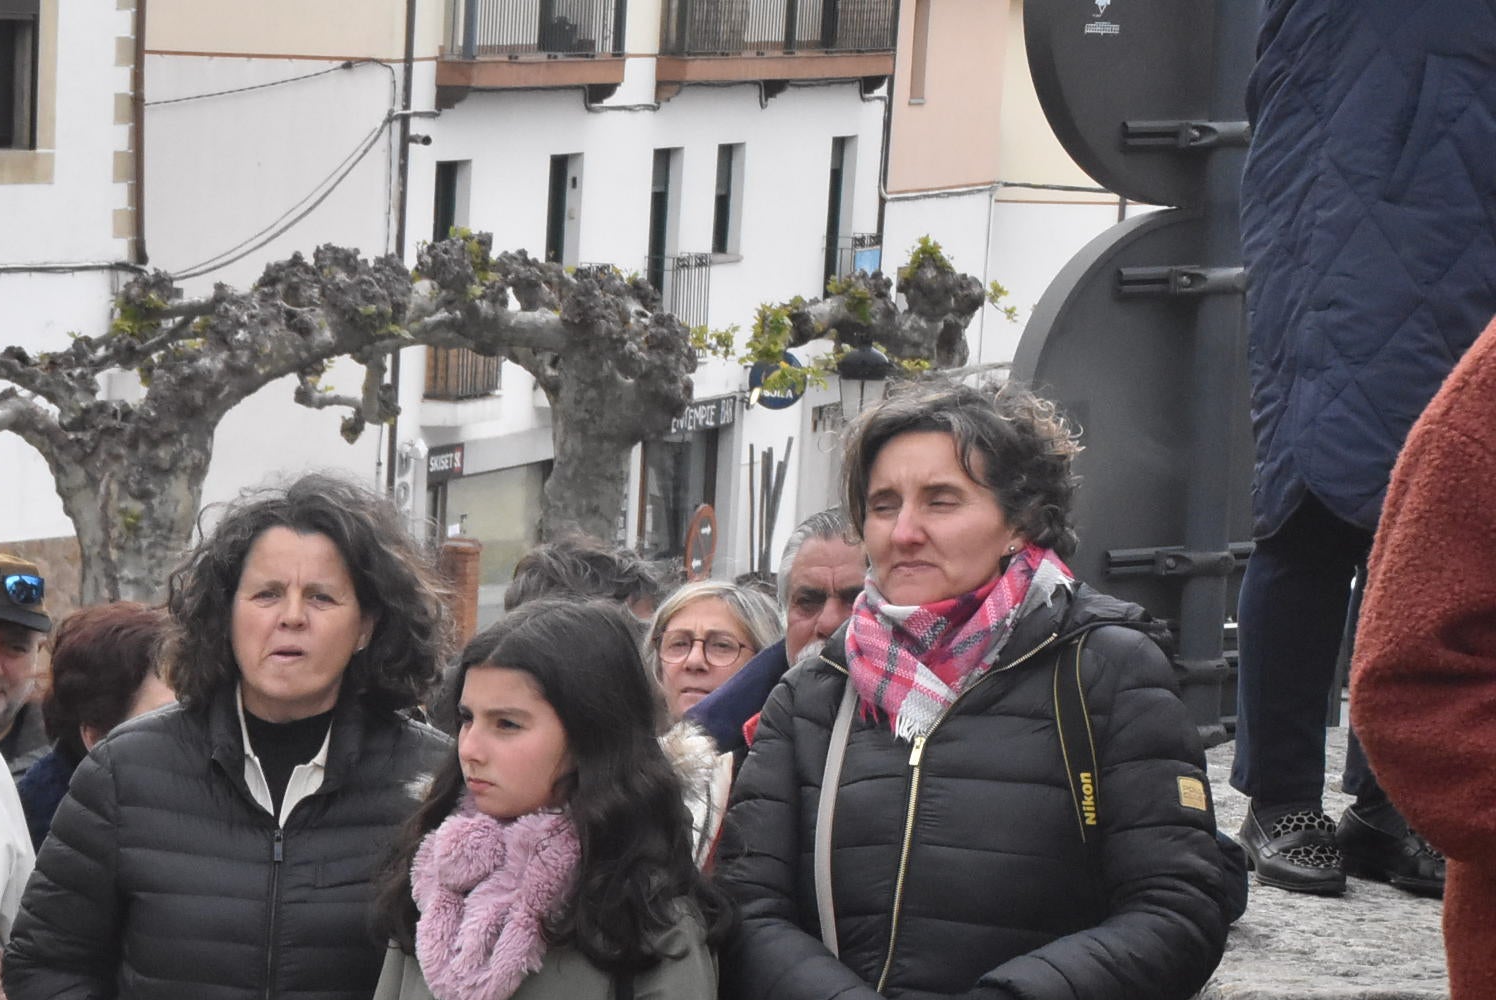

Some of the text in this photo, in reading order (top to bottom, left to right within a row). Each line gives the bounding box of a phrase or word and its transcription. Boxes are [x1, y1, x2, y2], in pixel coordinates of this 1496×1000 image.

[720, 398, 734, 425] BAR
[429, 453, 453, 472] SKISET
[1080, 772, 1097, 826] Nikon
